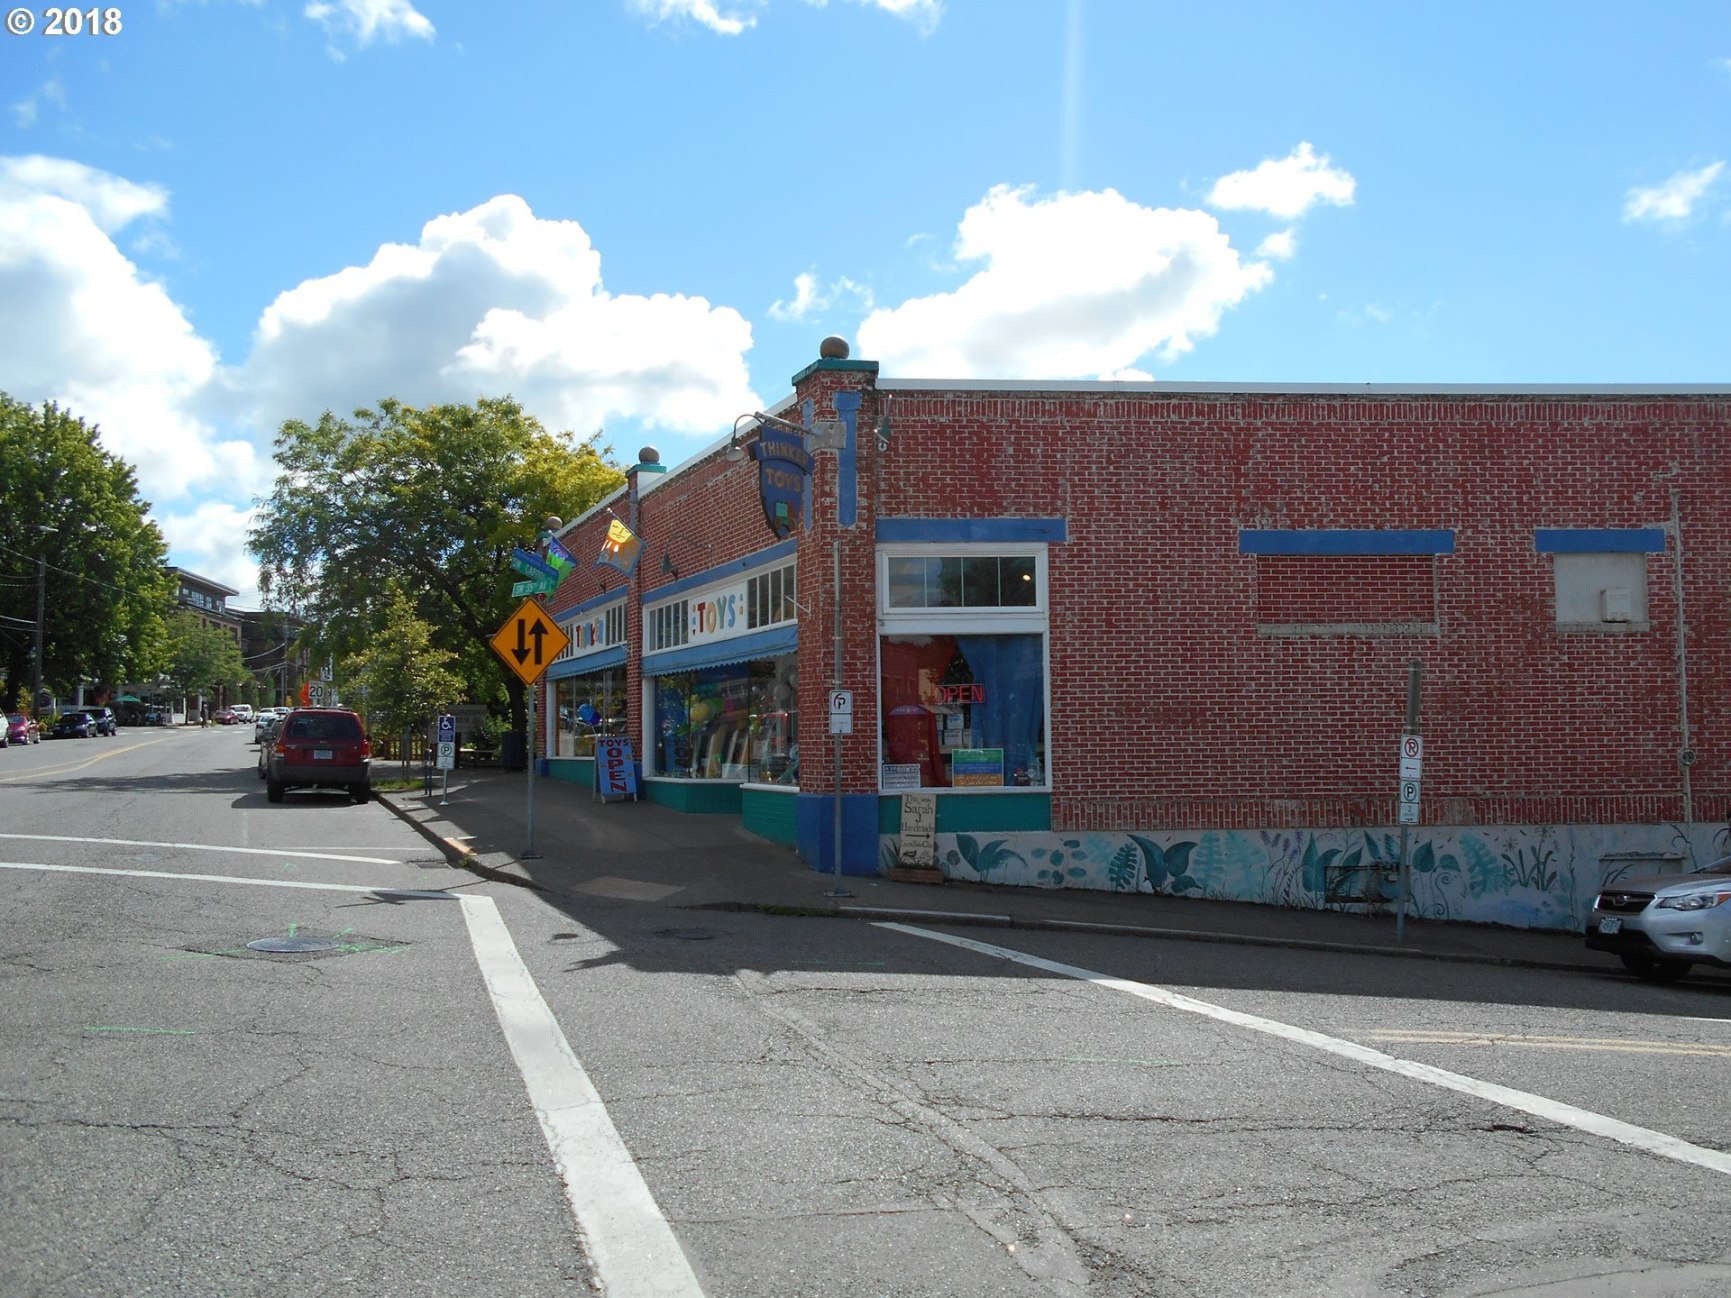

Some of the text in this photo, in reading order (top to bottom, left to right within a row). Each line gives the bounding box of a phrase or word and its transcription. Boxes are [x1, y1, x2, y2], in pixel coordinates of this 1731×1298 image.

[765, 467, 801, 493] TOYS
[697, 594, 736, 633] TOYS
[309, 686, 324, 698] 20
[935, 685, 984, 704] OPEN
[599, 738, 630, 748] TOYS
[607, 748, 628, 792] OPEN
[904, 801, 934, 814] Sarah
